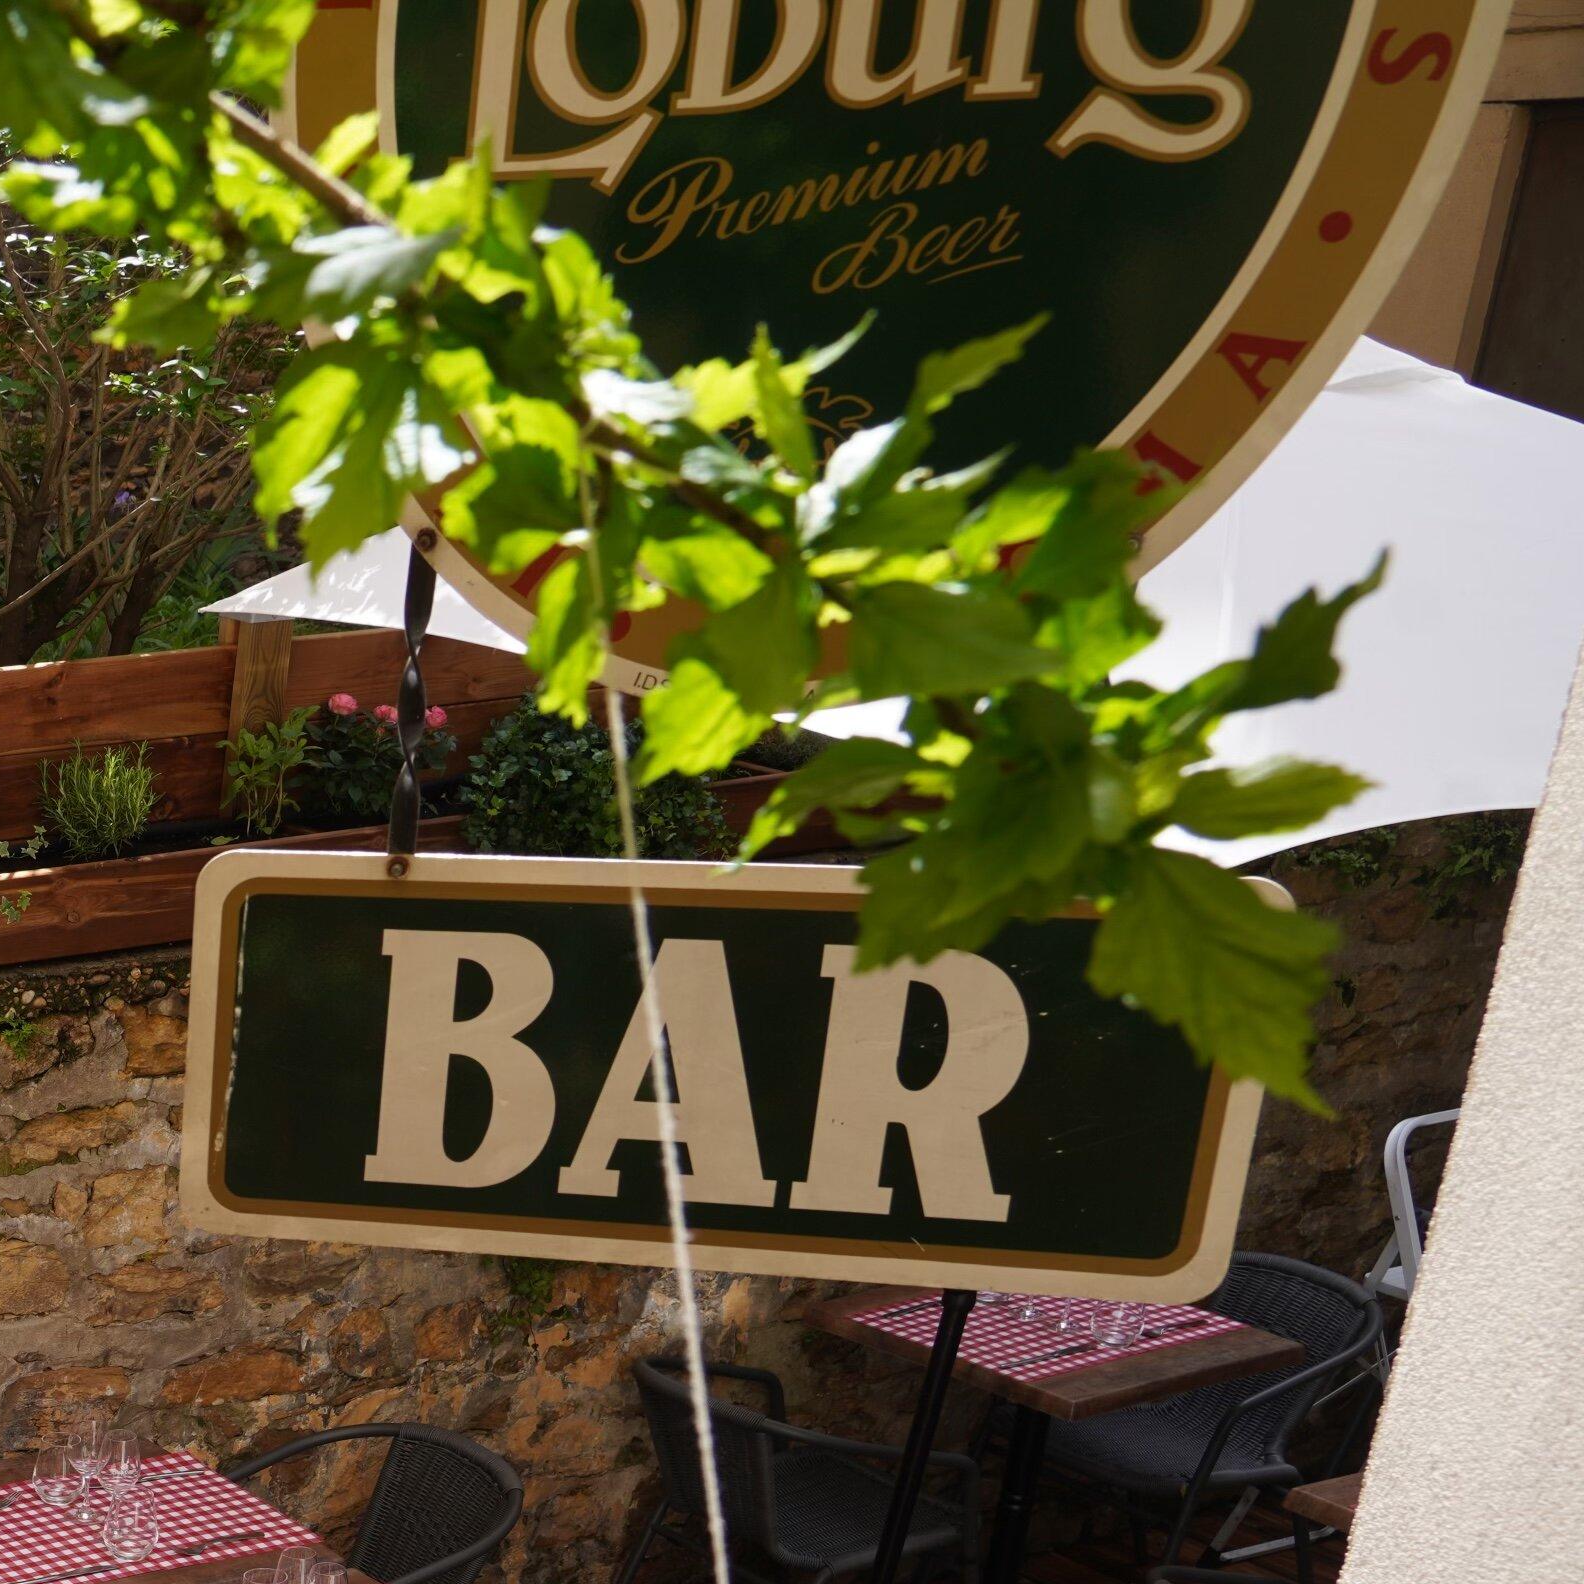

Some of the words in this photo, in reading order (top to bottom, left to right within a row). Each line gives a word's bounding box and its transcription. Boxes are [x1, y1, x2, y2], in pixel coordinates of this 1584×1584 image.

[616, 137, 988, 265] Premium
[812, 203, 1024, 295] Beer
[364, 928, 1029, 1223] BAR
